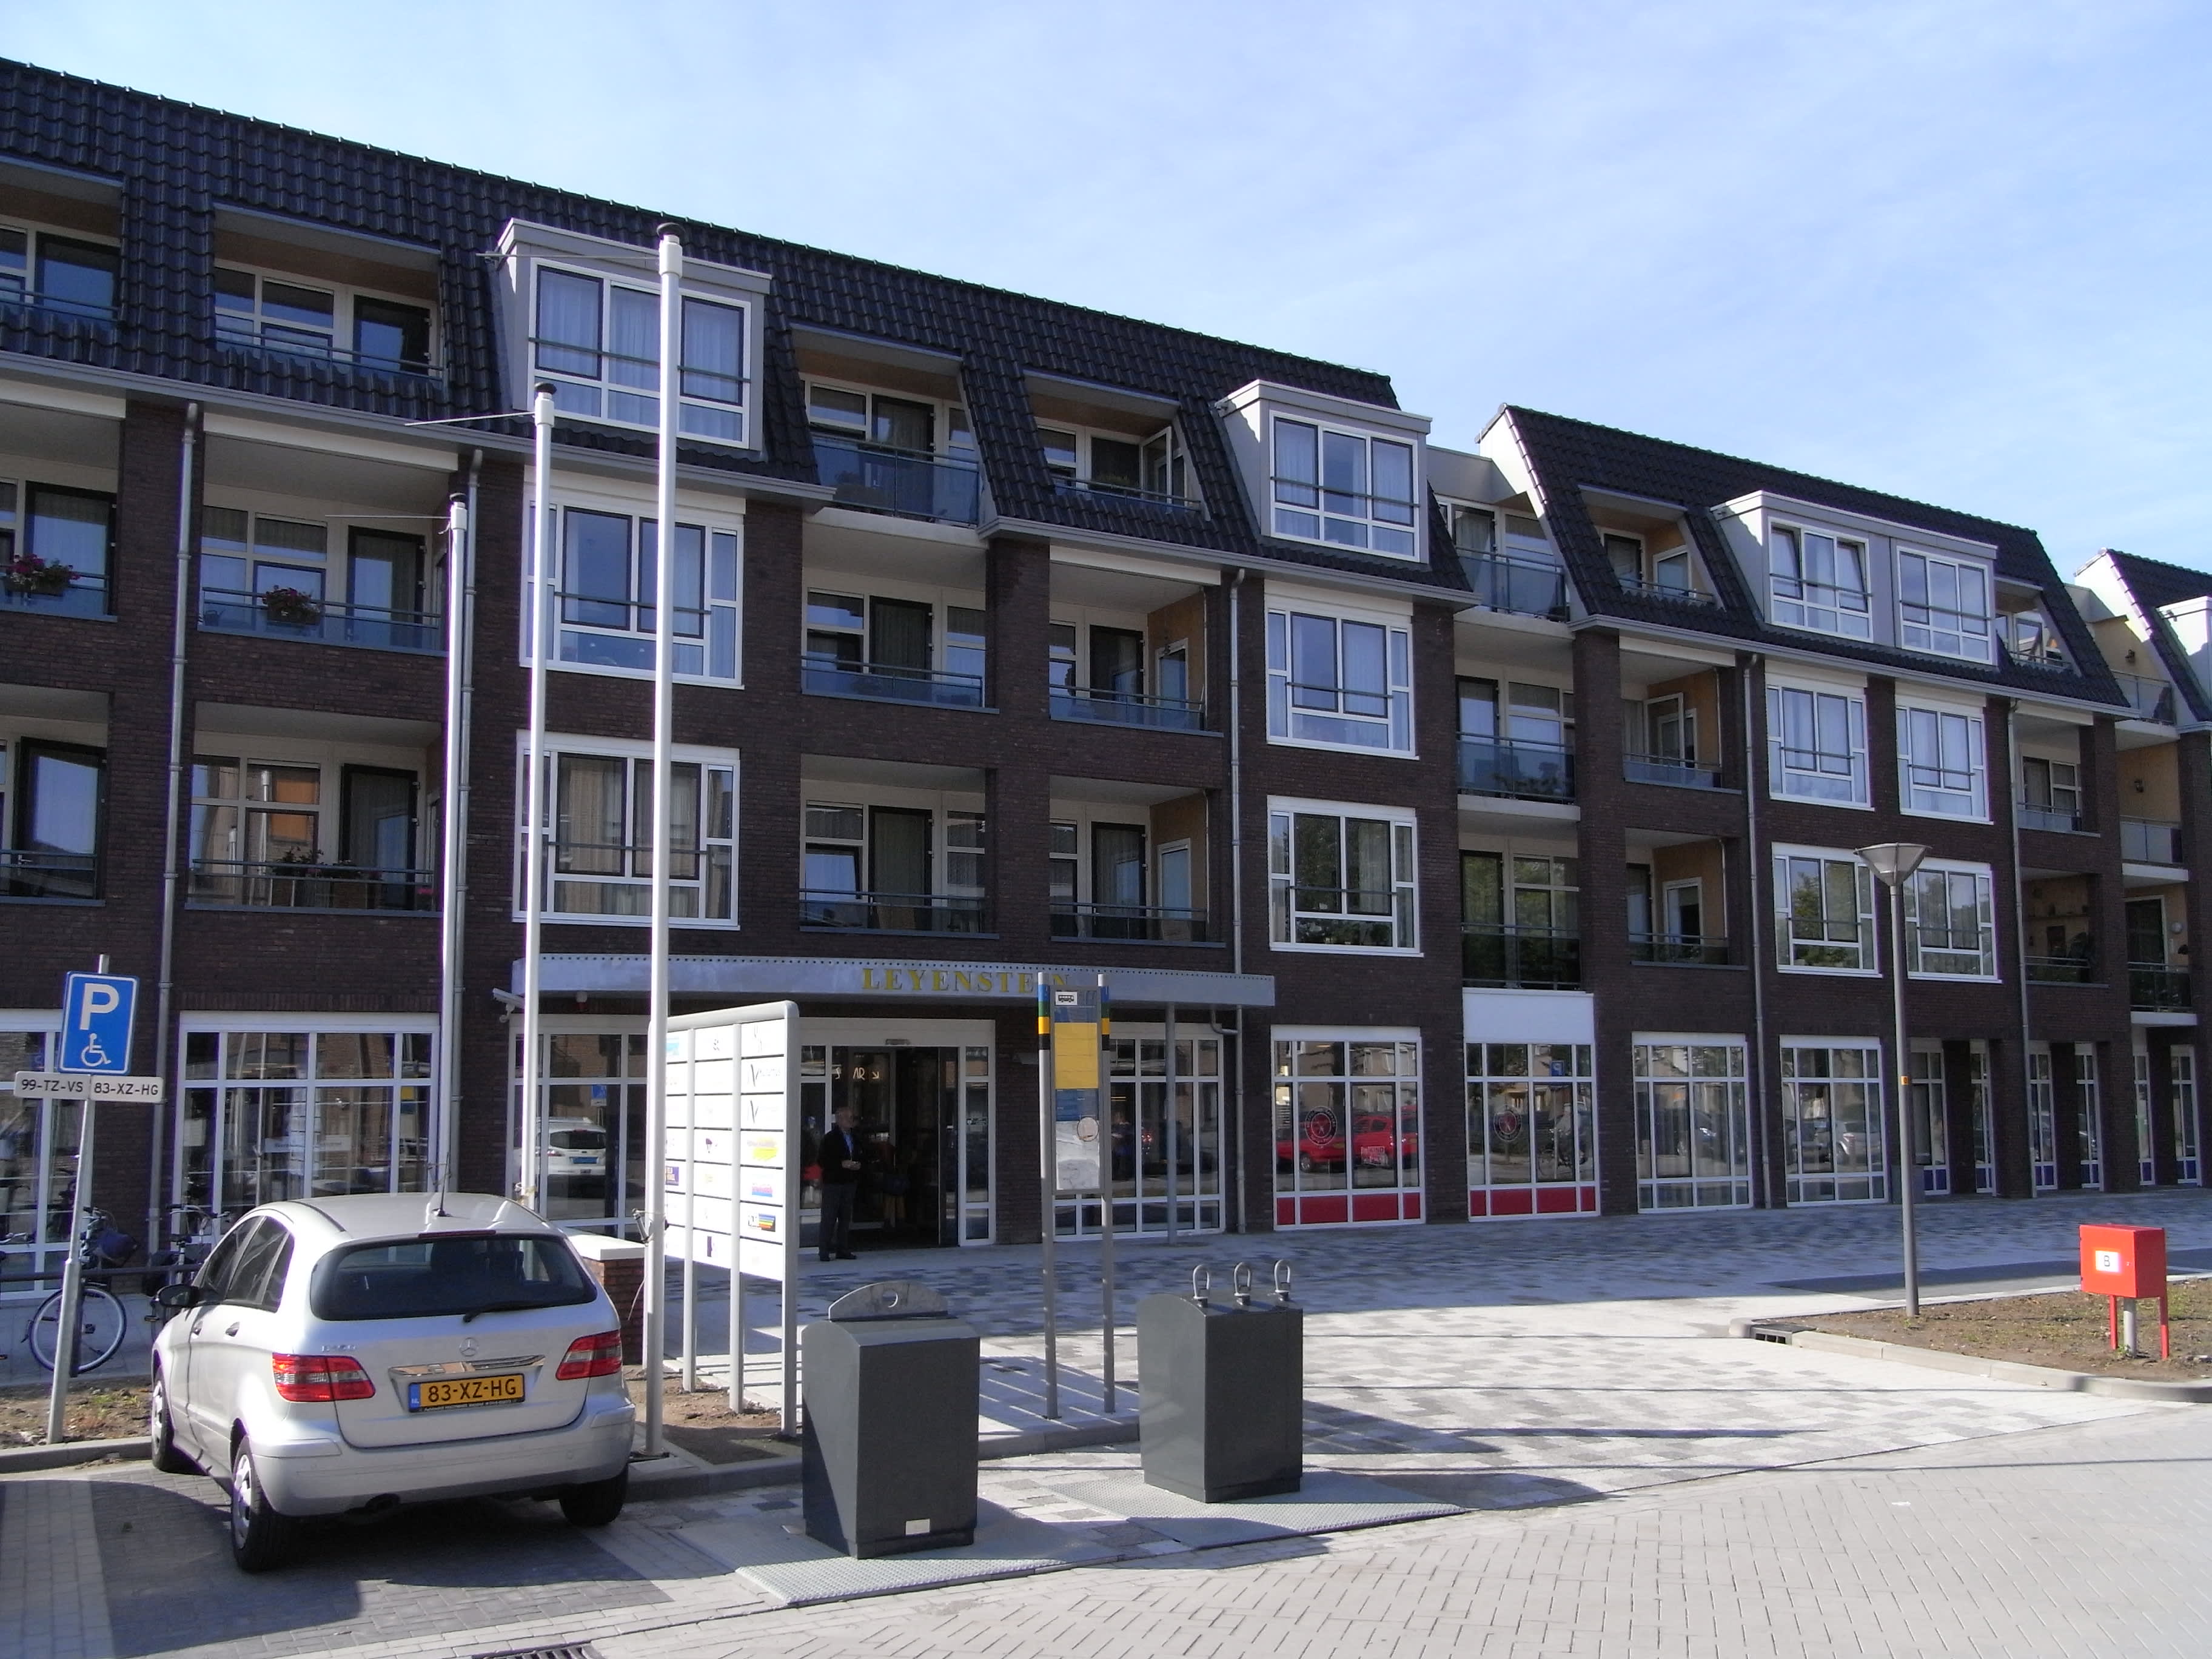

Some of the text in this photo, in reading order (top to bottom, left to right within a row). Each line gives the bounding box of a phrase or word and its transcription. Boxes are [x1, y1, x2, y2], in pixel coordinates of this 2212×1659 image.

[862, 968, 1070, 993] LEYENSTEN
[80, 982, 119, 1030] P
[21, 1079, 83, 1092] 99-TZ-VS
[94, 1083, 159, 1095] 83-XZ-HG
[428, 1378, 516, 1403] 83-XZ-HG
